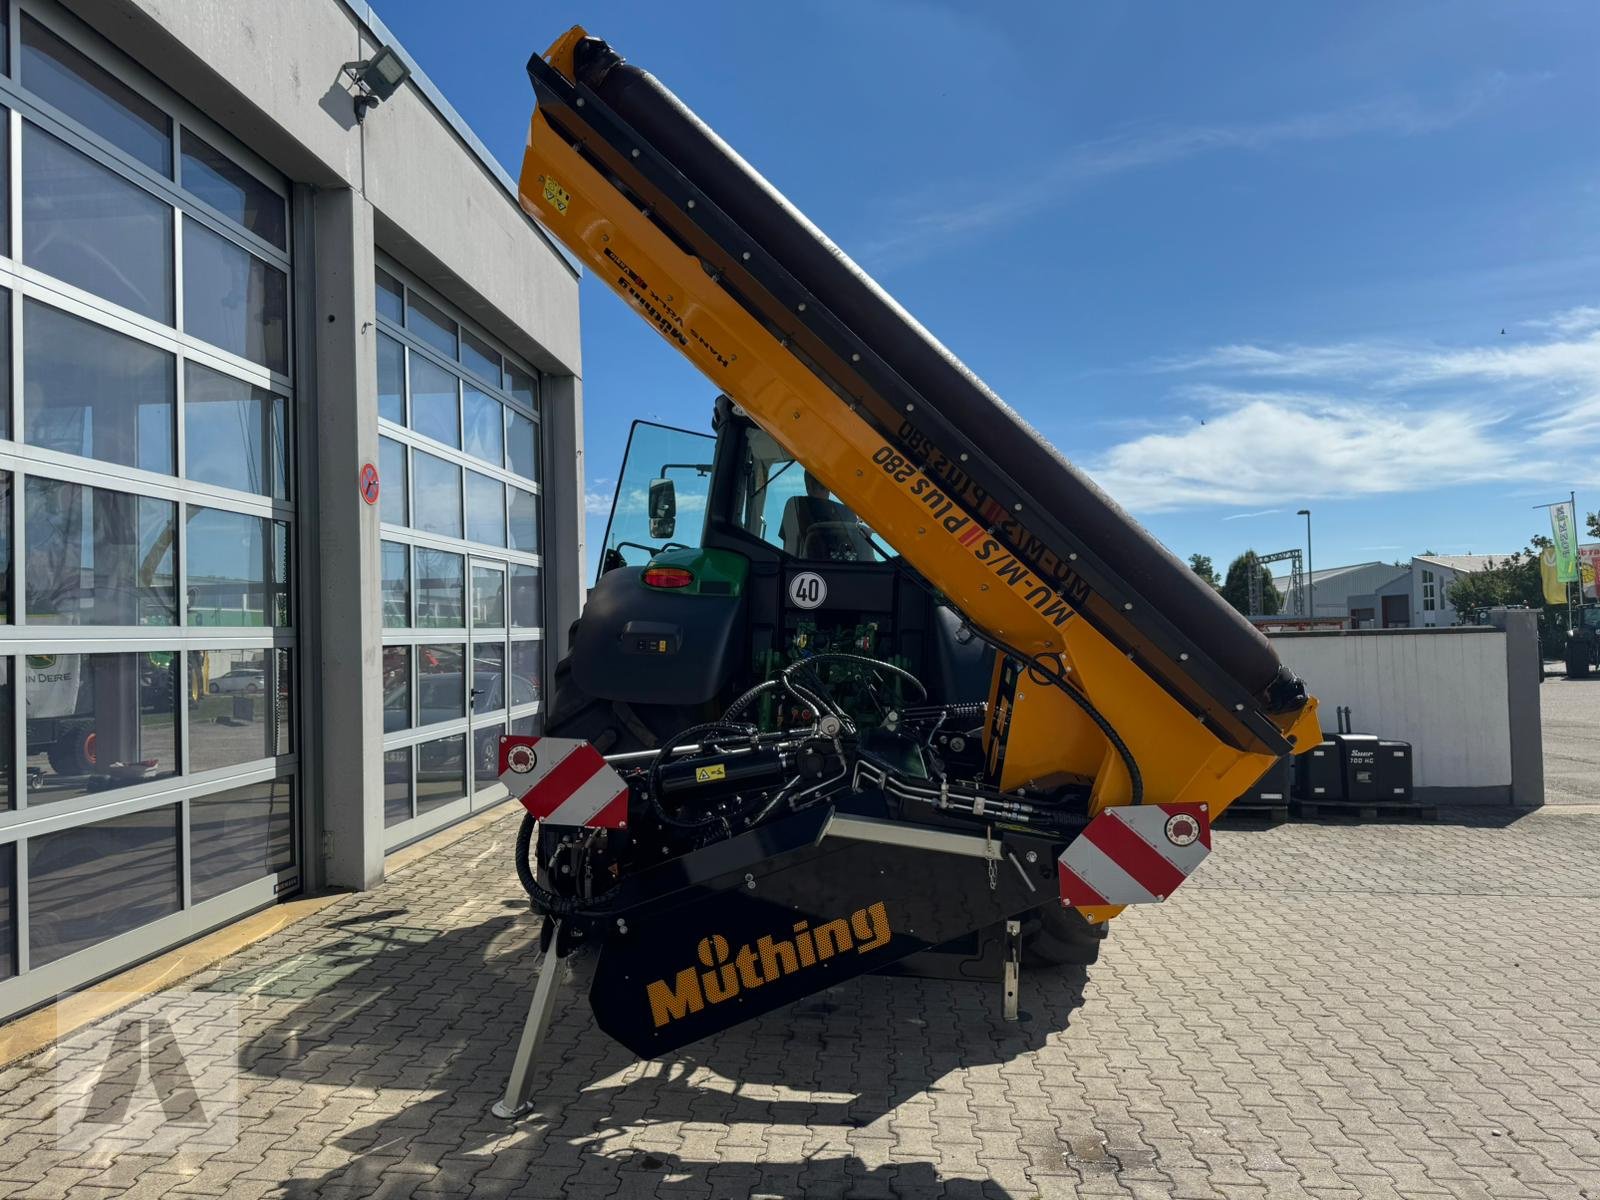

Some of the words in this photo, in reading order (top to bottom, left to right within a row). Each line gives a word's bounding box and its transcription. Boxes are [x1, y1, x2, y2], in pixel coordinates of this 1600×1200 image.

[618, 276, 688, 347] Müthing
[690, 328, 729, 368] HANS
[872, 445, 917, 485] 280
[910, 478, 970, 534] Plus
[796, 578, 819, 602] 40
[974, 538, 1076, 628] MU-M/S
[1351, 749, 1374, 757] Suer
[646, 901, 893, 1028] Müthing
